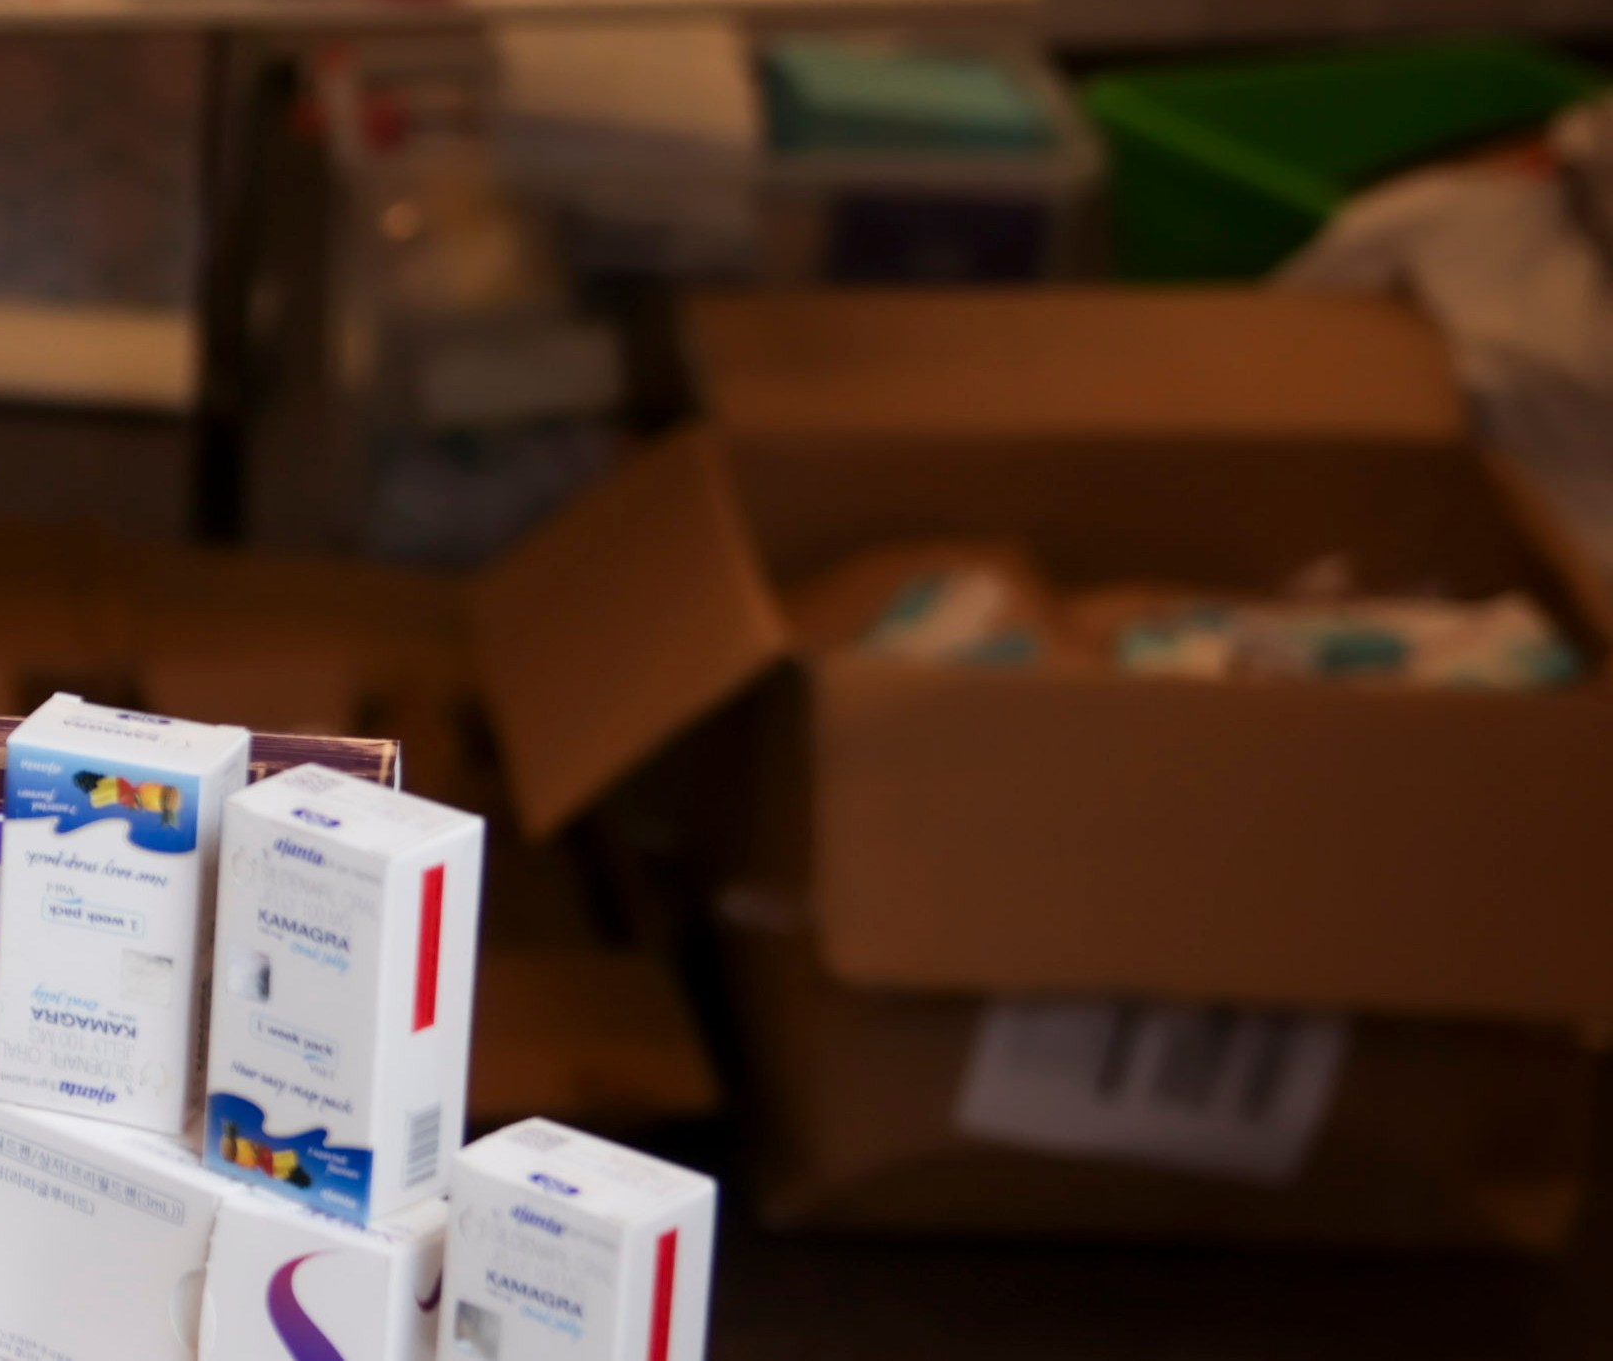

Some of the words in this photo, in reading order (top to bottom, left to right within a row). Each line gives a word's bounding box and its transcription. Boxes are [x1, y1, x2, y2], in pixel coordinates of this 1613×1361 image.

[49, 903, 84, 922] pack
[86, 912, 125, 927] week
[257, 908, 350, 952] KAMAGRA
[30, 1006, 138, 1039] KAMAGRA
[267, 1024, 300, 1045] week
[303, 1037, 333, 1057] pack
[486, 1269, 584, 1318] KAMAGRA
